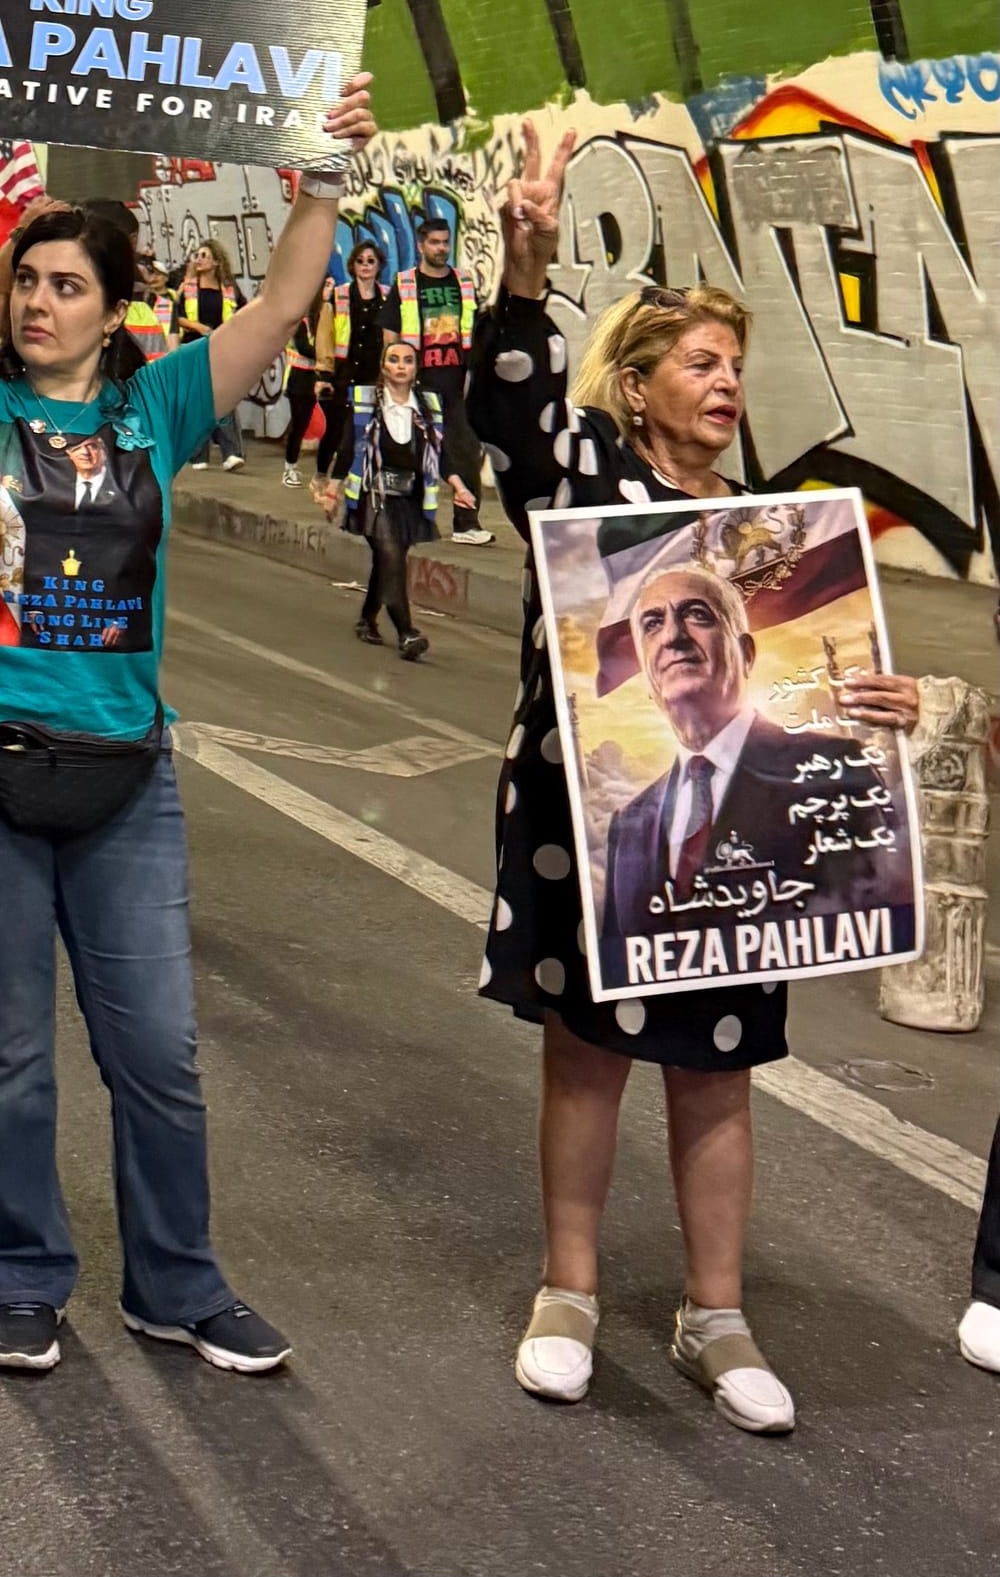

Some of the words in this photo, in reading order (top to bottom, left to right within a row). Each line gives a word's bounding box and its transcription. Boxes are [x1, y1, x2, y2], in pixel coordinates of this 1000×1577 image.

[29, 21, 344, 102] PAHLAVI
[137, 92, 214, 120] FOR
[42, 576, 106, 593] KING
[3, 590, 58, 608] REZA
[22, 611, 76, 627] LONG
[81, 614, 129, 630] LIVE
[39, 630, 104, 647] SHAH
[769, 666, 826, 701] کشور
[783, 708, 832, 735] ملت
[792, 752, 841, 784] رهبر
[843, 743, 889, 772] یک
[788, 792, 849, 826] پرچم
[850, 785, 895, 813] یک
[803, 827, 852, 865] شعار
[854, 826, 898, 853] یک
[625, 927, 730, 985] REZA
[735, 907, 893, 972] PAHLAVI
